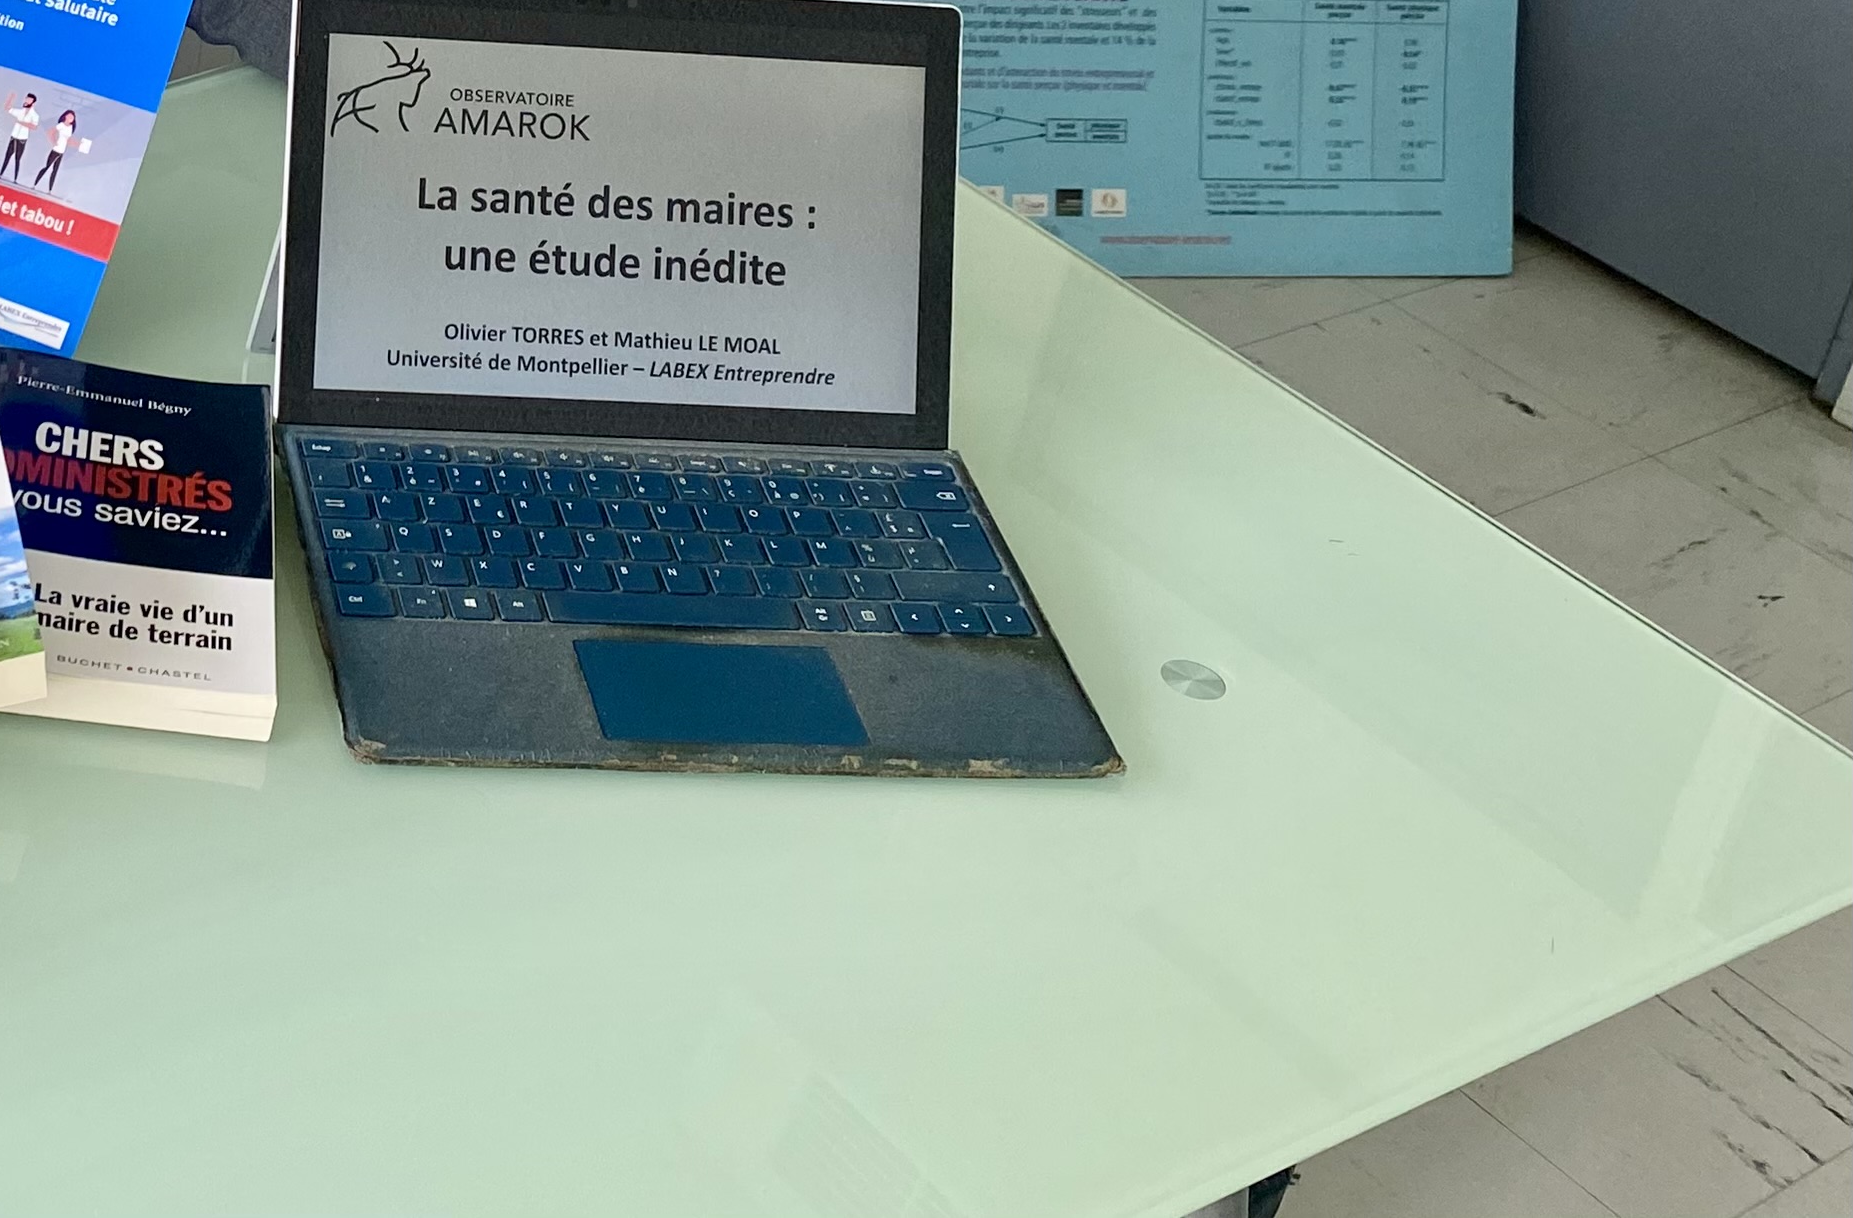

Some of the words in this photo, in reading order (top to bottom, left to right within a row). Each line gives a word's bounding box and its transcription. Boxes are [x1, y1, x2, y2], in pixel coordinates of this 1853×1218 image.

[449, 88, 575, 108] OBSERVATOIRE
[433, 107, 591, 142] AMAROK
[19, 201, 64, 234] tabou
[418, 178, 458, 212] La
[470, 181, 574, 218] santé
[587, 185, 654, 222] des
[665, 193, 794, 229] maires
[806, 202, 816, 229] :
[444, 242, 517, 273] une
[529, 242, 641, 279] étude
[653, 247, 787, 286] inédite
[444, 323, 507, 344] Olivier
[512, 325, 585, 347] TORRES
[589, 331, 608, 348] et
[613, 329, 694, 351] Mathieu
[699, 334, 718, 352] LE
[723, 334, 781, 355] MOAL
[386, 348, 482, 370] Université
[487, 351, 512, 371] de
[517, 353, 628, 378] Montpellier
[649, 360, 709, 381] LABEX
[713, 363, 835, 387] Entreprendre
[17, 374, 144, 410] Pierre-Emmanuel
[148, 397, 193, 418] Bégny
[35, 421, 165, 470] CHERS
[94, 500, 229, 538] saviez...
[34, 582, 62, 606] La
[71, 593, 131, 616] vraie
[141, 600, 175, 621] vie
[182, 603, 234, 627] d'un
[108, 618, 139, 640] de
[148, 621, 233, 652] terrain
[57, 654, 122, 672] BUCHET
[137, 665, 212, 682] CHASTEL
